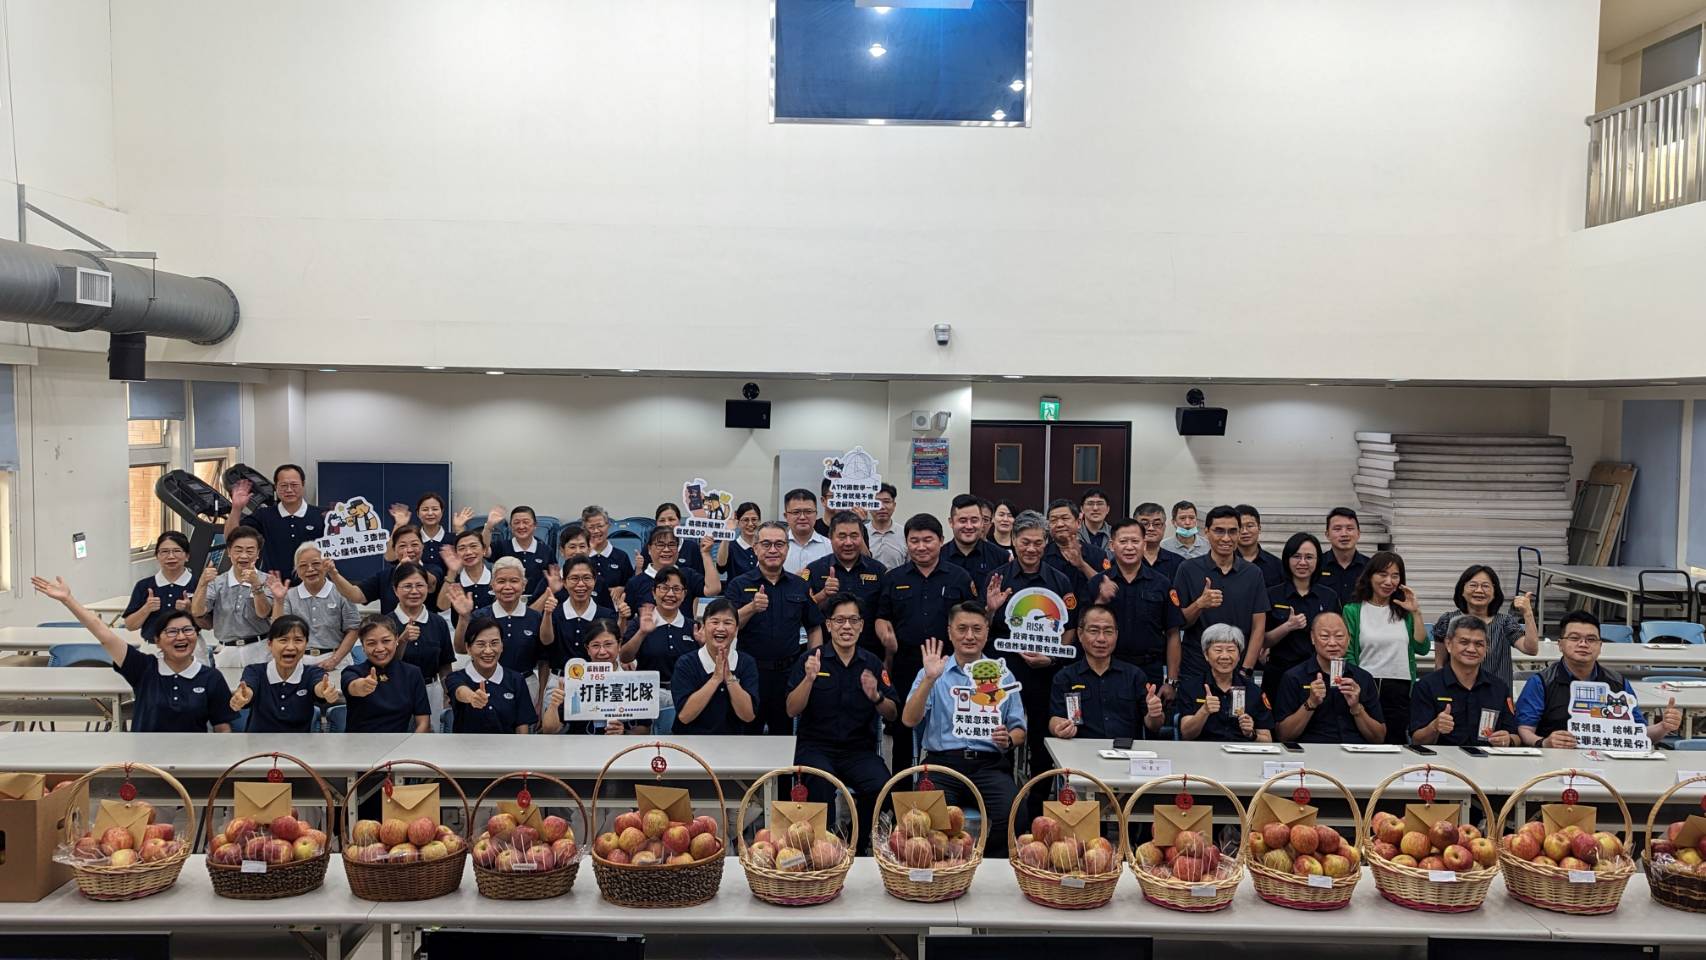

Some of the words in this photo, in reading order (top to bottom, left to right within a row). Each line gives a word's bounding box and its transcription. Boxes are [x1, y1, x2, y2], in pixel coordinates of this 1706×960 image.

[1026, 622, 1044, 632] RISK
[1013, 631, 1060, 645] 投資有賺有賠
[579, 682, 654, 703] 打詐臺北隊
[955, 726, 994, 736] 小心是詐
